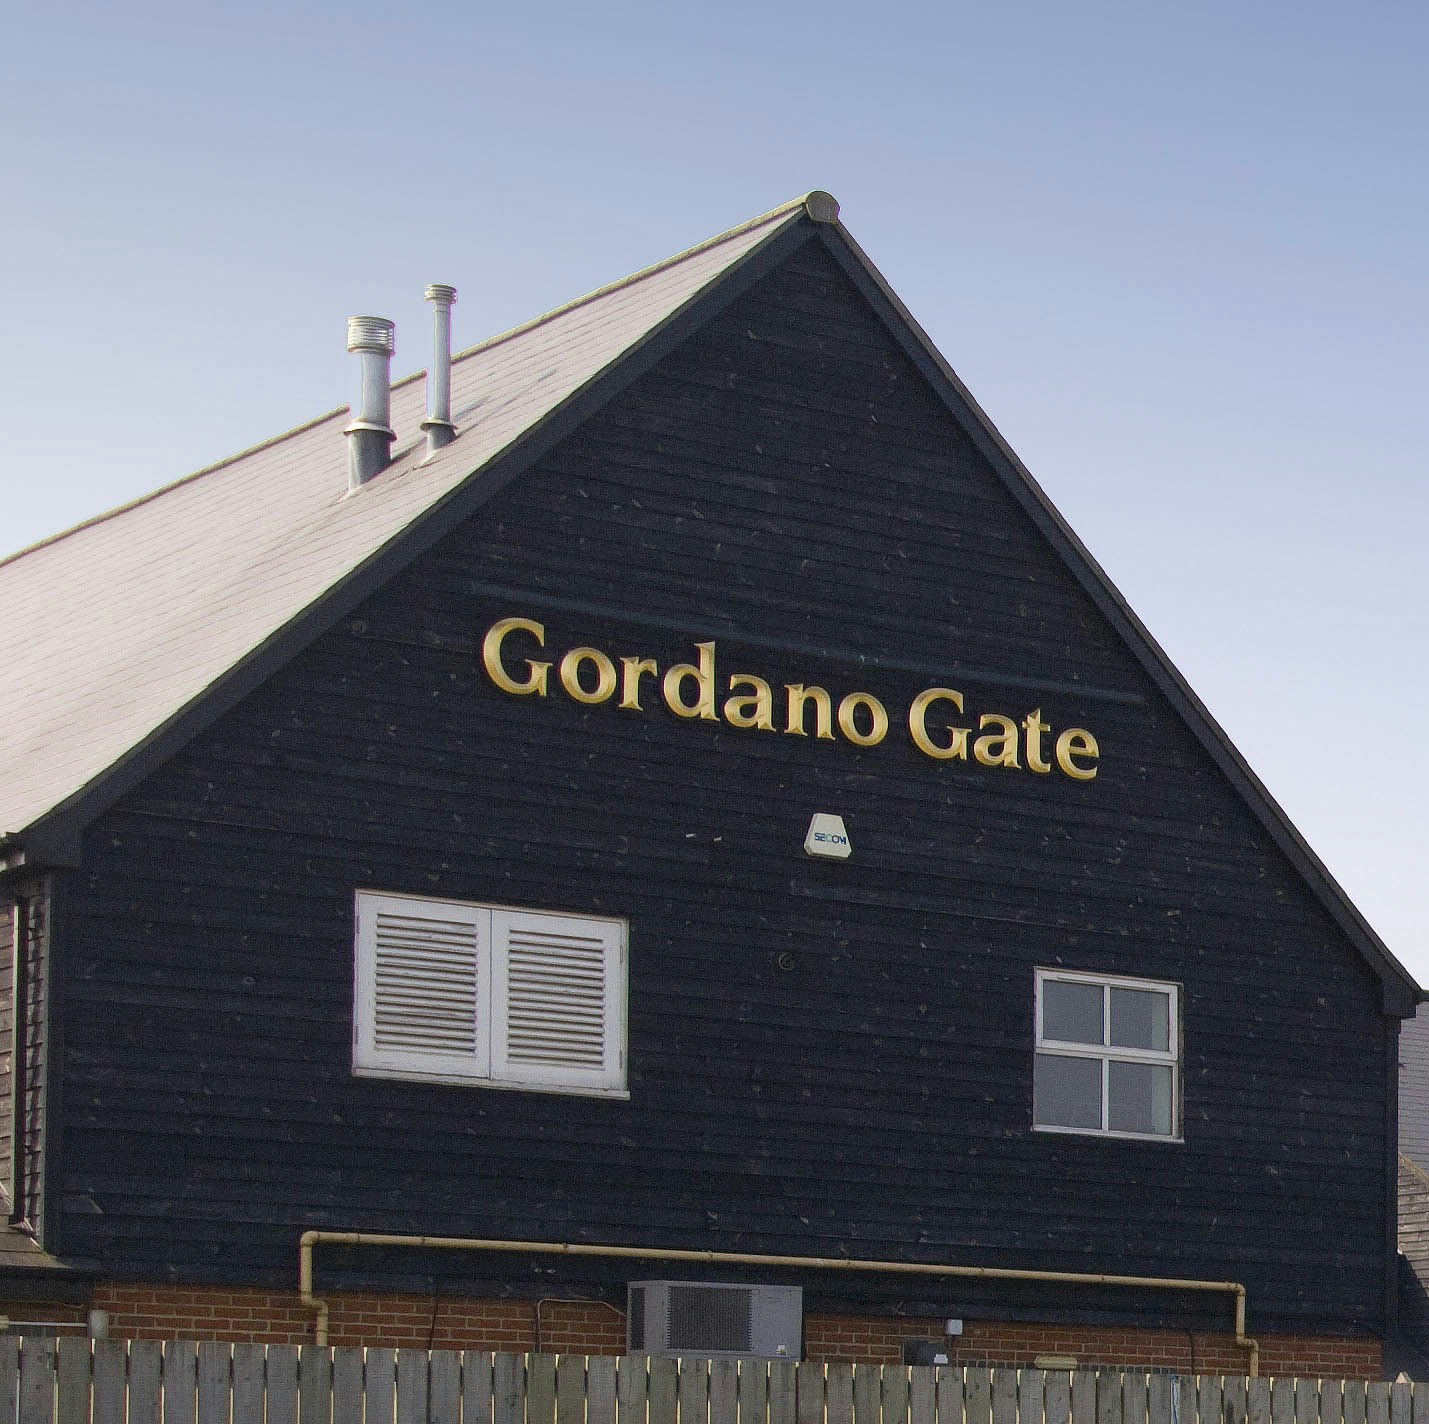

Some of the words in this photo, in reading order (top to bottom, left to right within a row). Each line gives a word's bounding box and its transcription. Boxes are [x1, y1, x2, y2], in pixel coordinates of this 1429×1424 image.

[482, 616, 889, 747] Gordano
[908, 687, 1100, 780] Gate
[814, 832, 847, 845] SECOM
